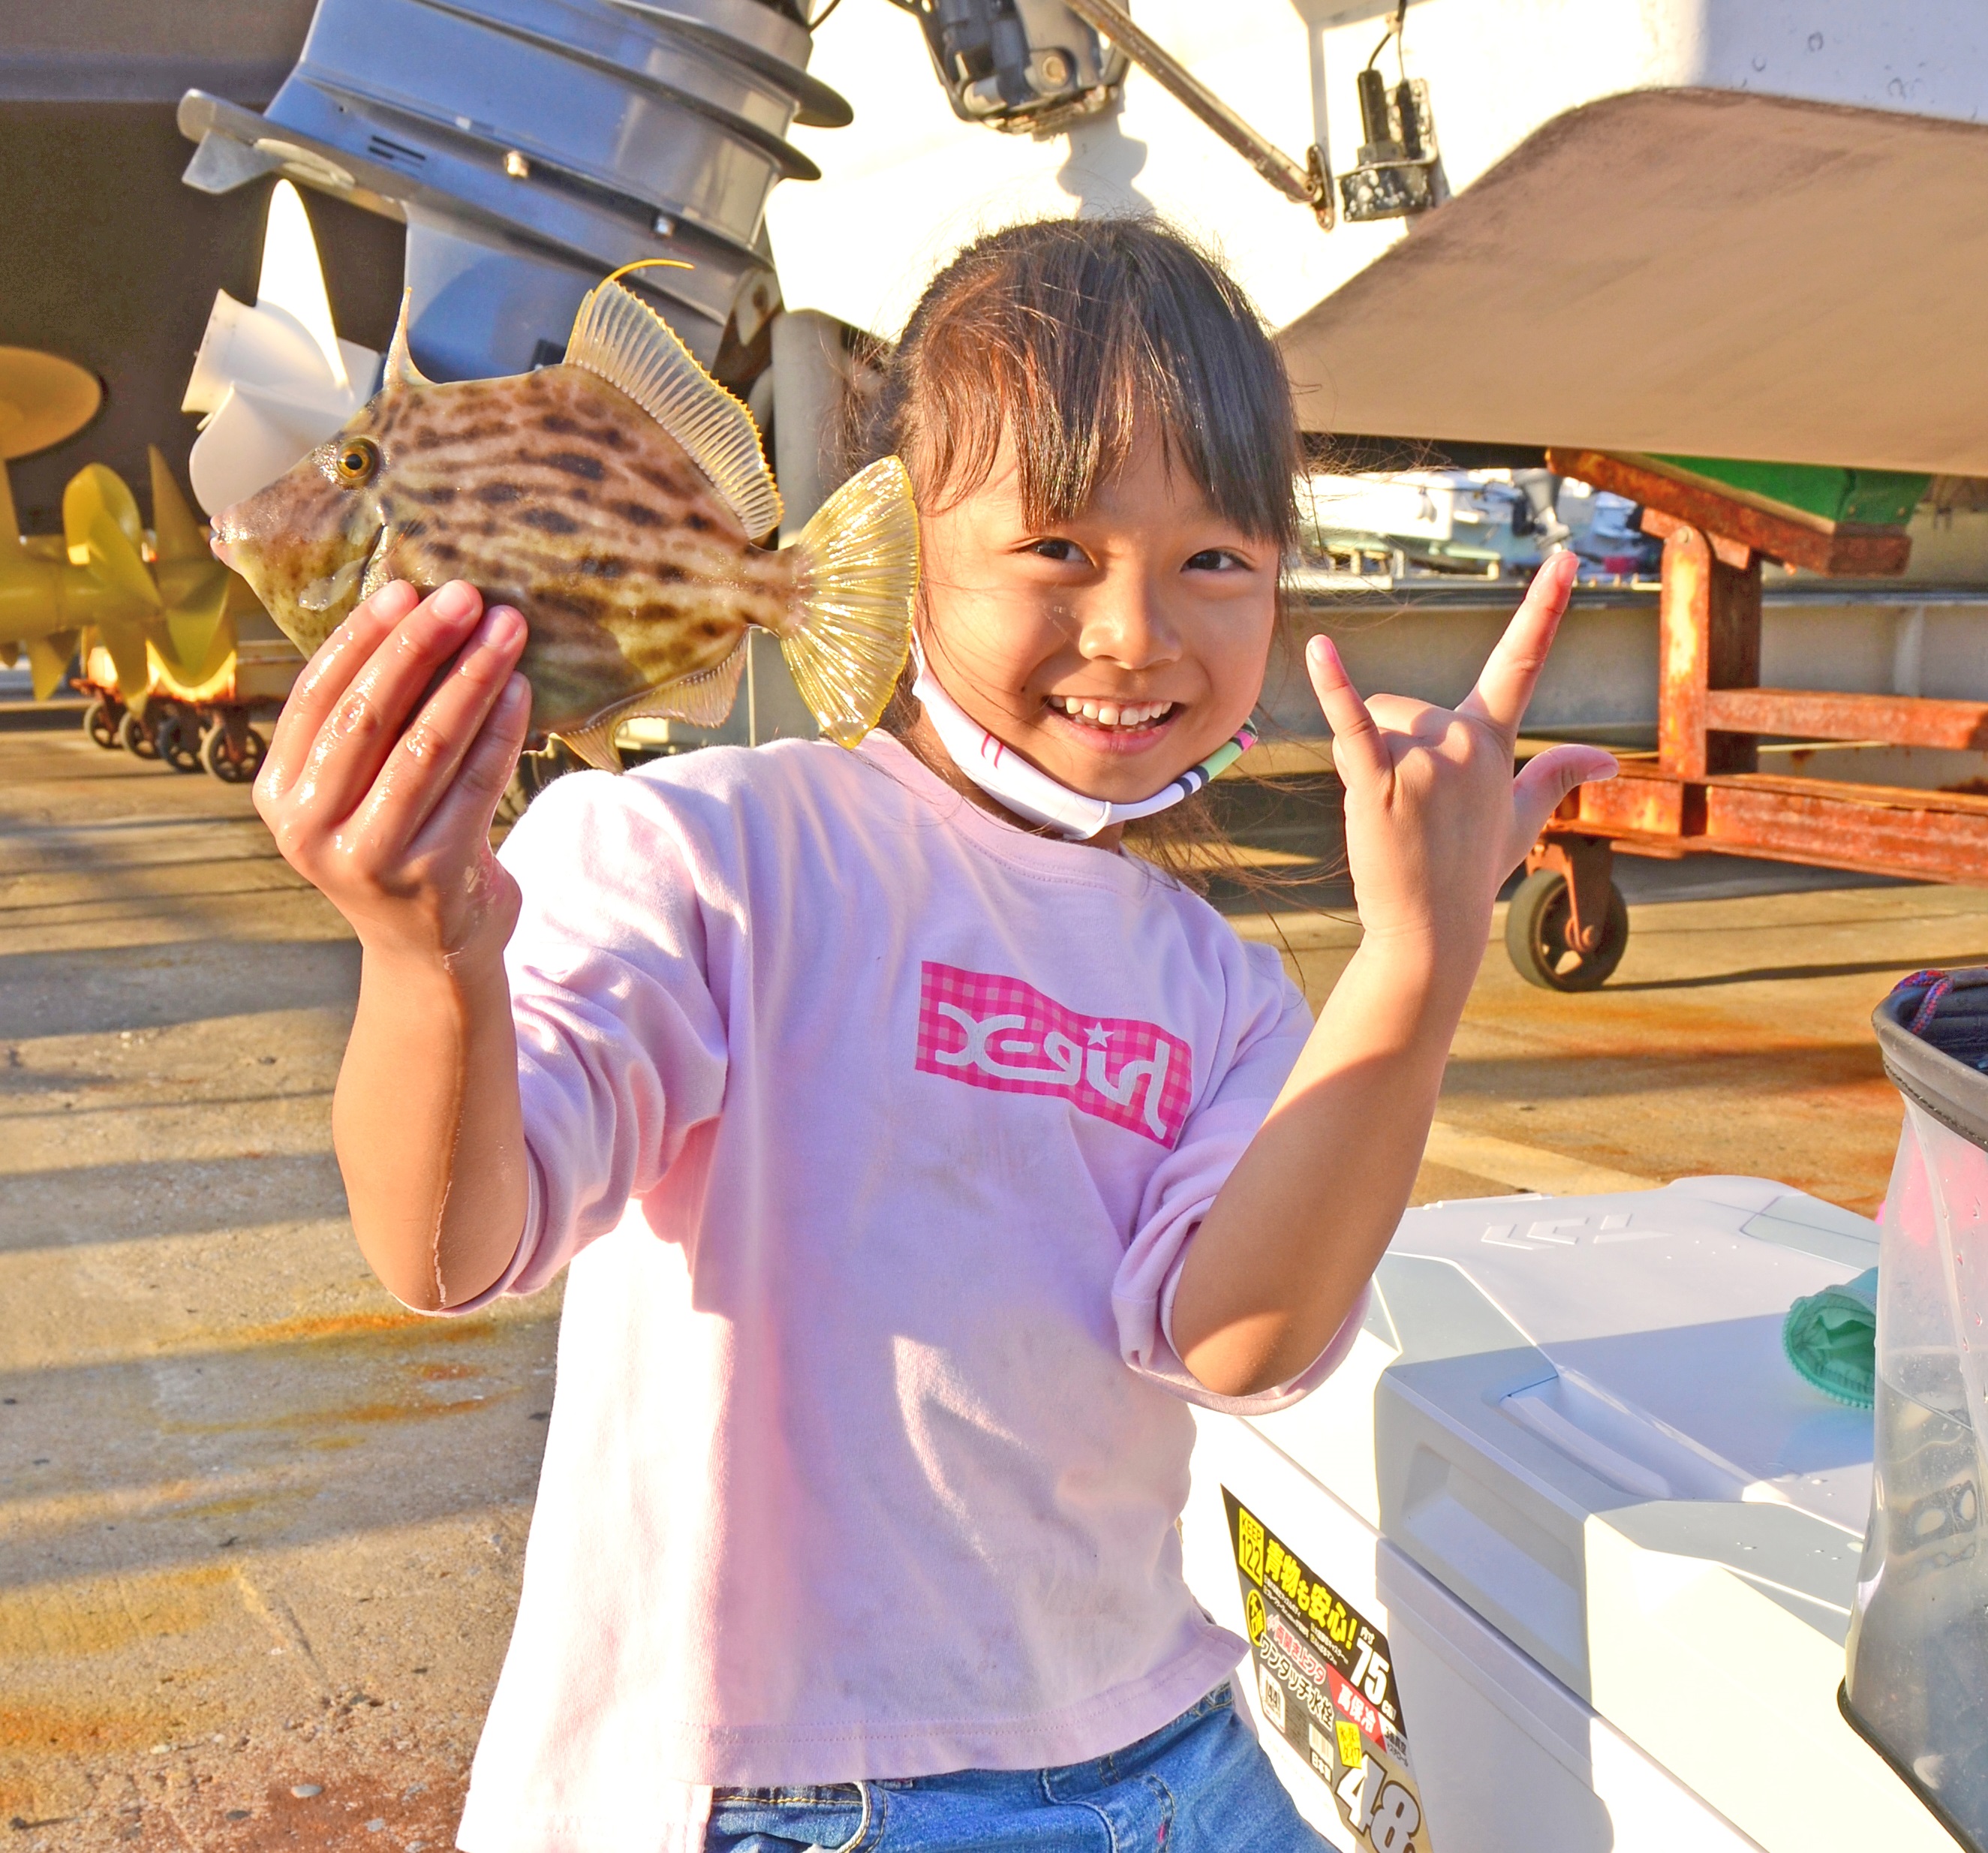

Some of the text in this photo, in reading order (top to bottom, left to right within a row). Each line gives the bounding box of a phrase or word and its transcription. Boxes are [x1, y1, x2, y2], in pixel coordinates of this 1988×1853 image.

[935, 1002, 1170, 1139] X-girl
[1242, 1514, 1262, 1544] KEEP
[1243, 1534, 1261, 1579] 122
[1259, 1632, 1334, 1732] ワンタッチ水栓
[1337, 1683, 1376, 1734] 高保冷
